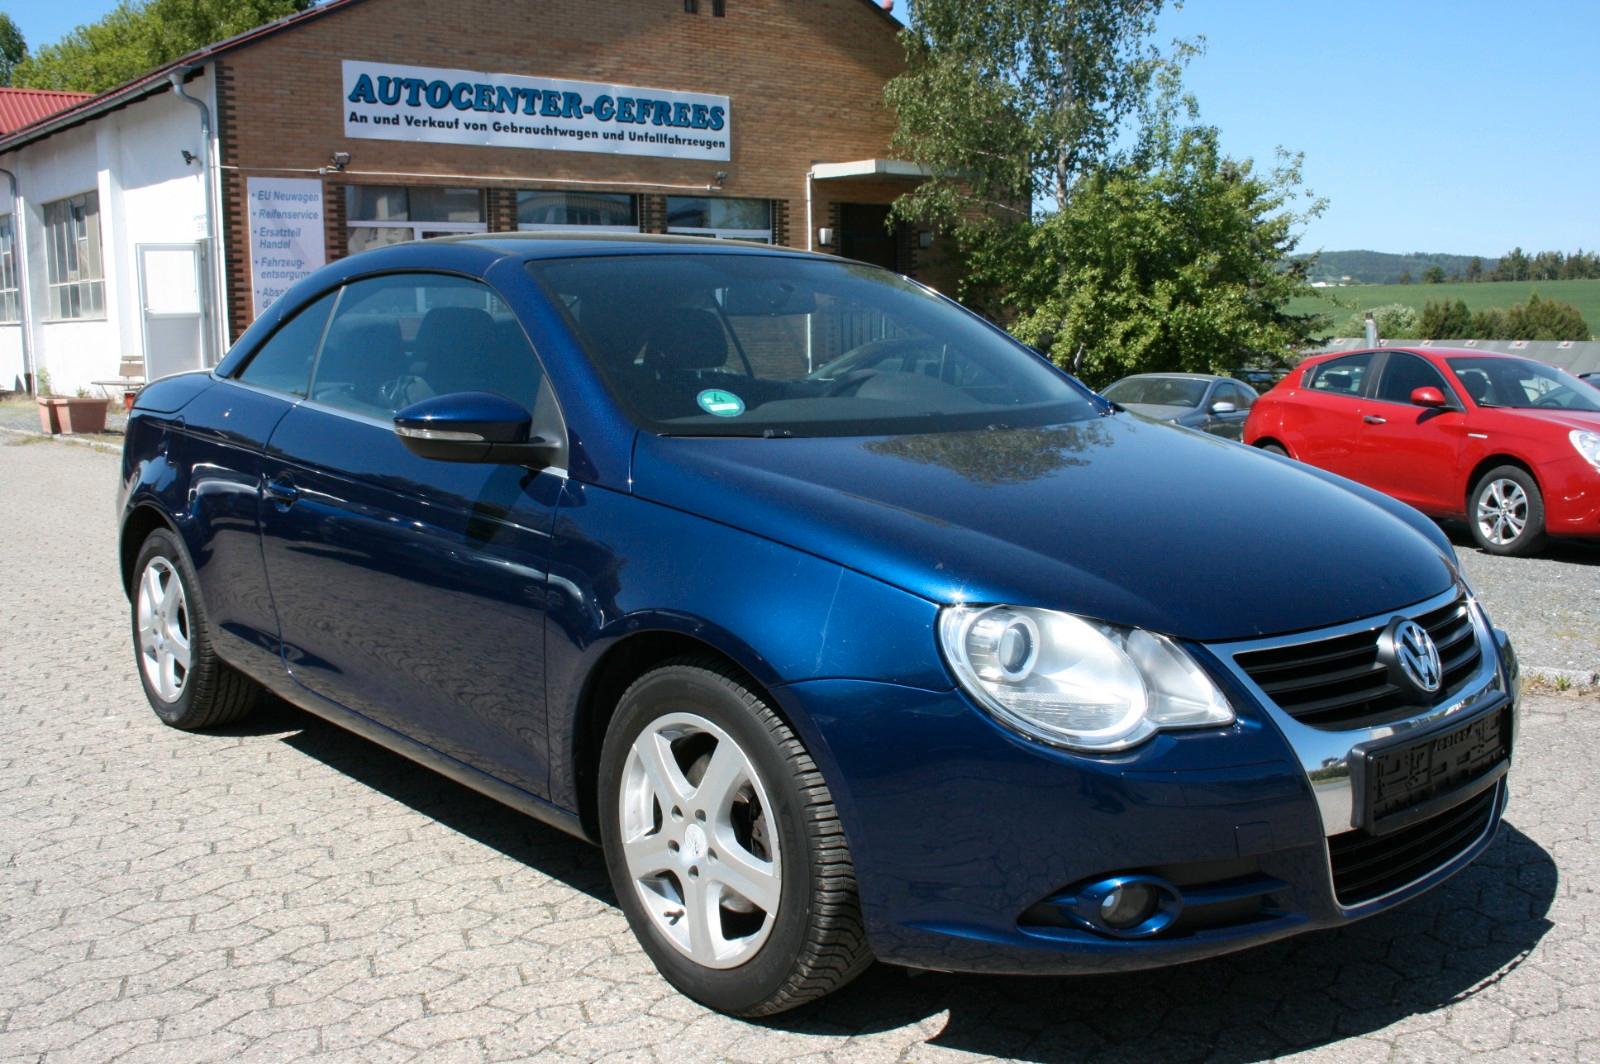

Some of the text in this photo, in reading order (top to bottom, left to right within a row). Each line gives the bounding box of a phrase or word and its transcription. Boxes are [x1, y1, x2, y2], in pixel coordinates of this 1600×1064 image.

[348, 74, 725, 131] AUTOCENTER-GEFREES
[349, 111, 726, 150] An und Verkauf von Gebrauchtwagen und Unfallfahrzeugen
[257, 190, 319, 203] EU Neuwagen
[259, 208, 319, 220] Reifenservice
[260, 227, 301, 237] Ersatzteil
[260, 239, 291, 249] Handel
[261, 257, 305, 269] Fahrzeug-
